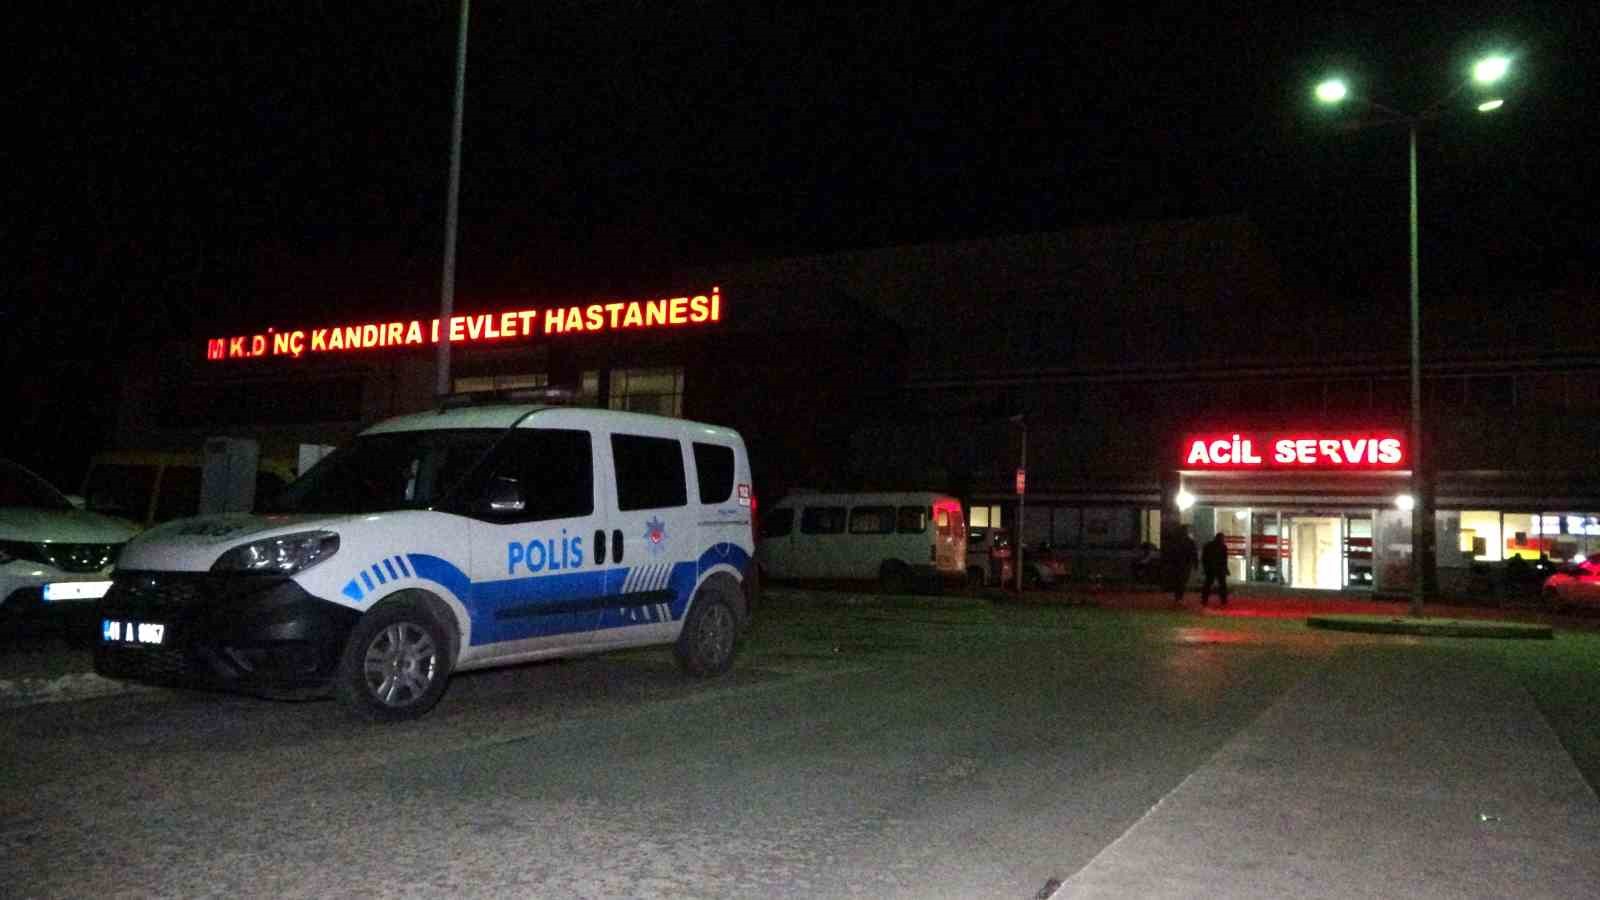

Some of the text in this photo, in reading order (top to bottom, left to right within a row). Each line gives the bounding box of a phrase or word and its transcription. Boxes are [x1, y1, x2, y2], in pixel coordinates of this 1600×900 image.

[310, 320, 424, 353] KANDIRA
[544, 286, 721, 335] HASTANESİ
[1187, 433, 1262, 465] ACİL
[507, 528, 584, 575] POLİS
